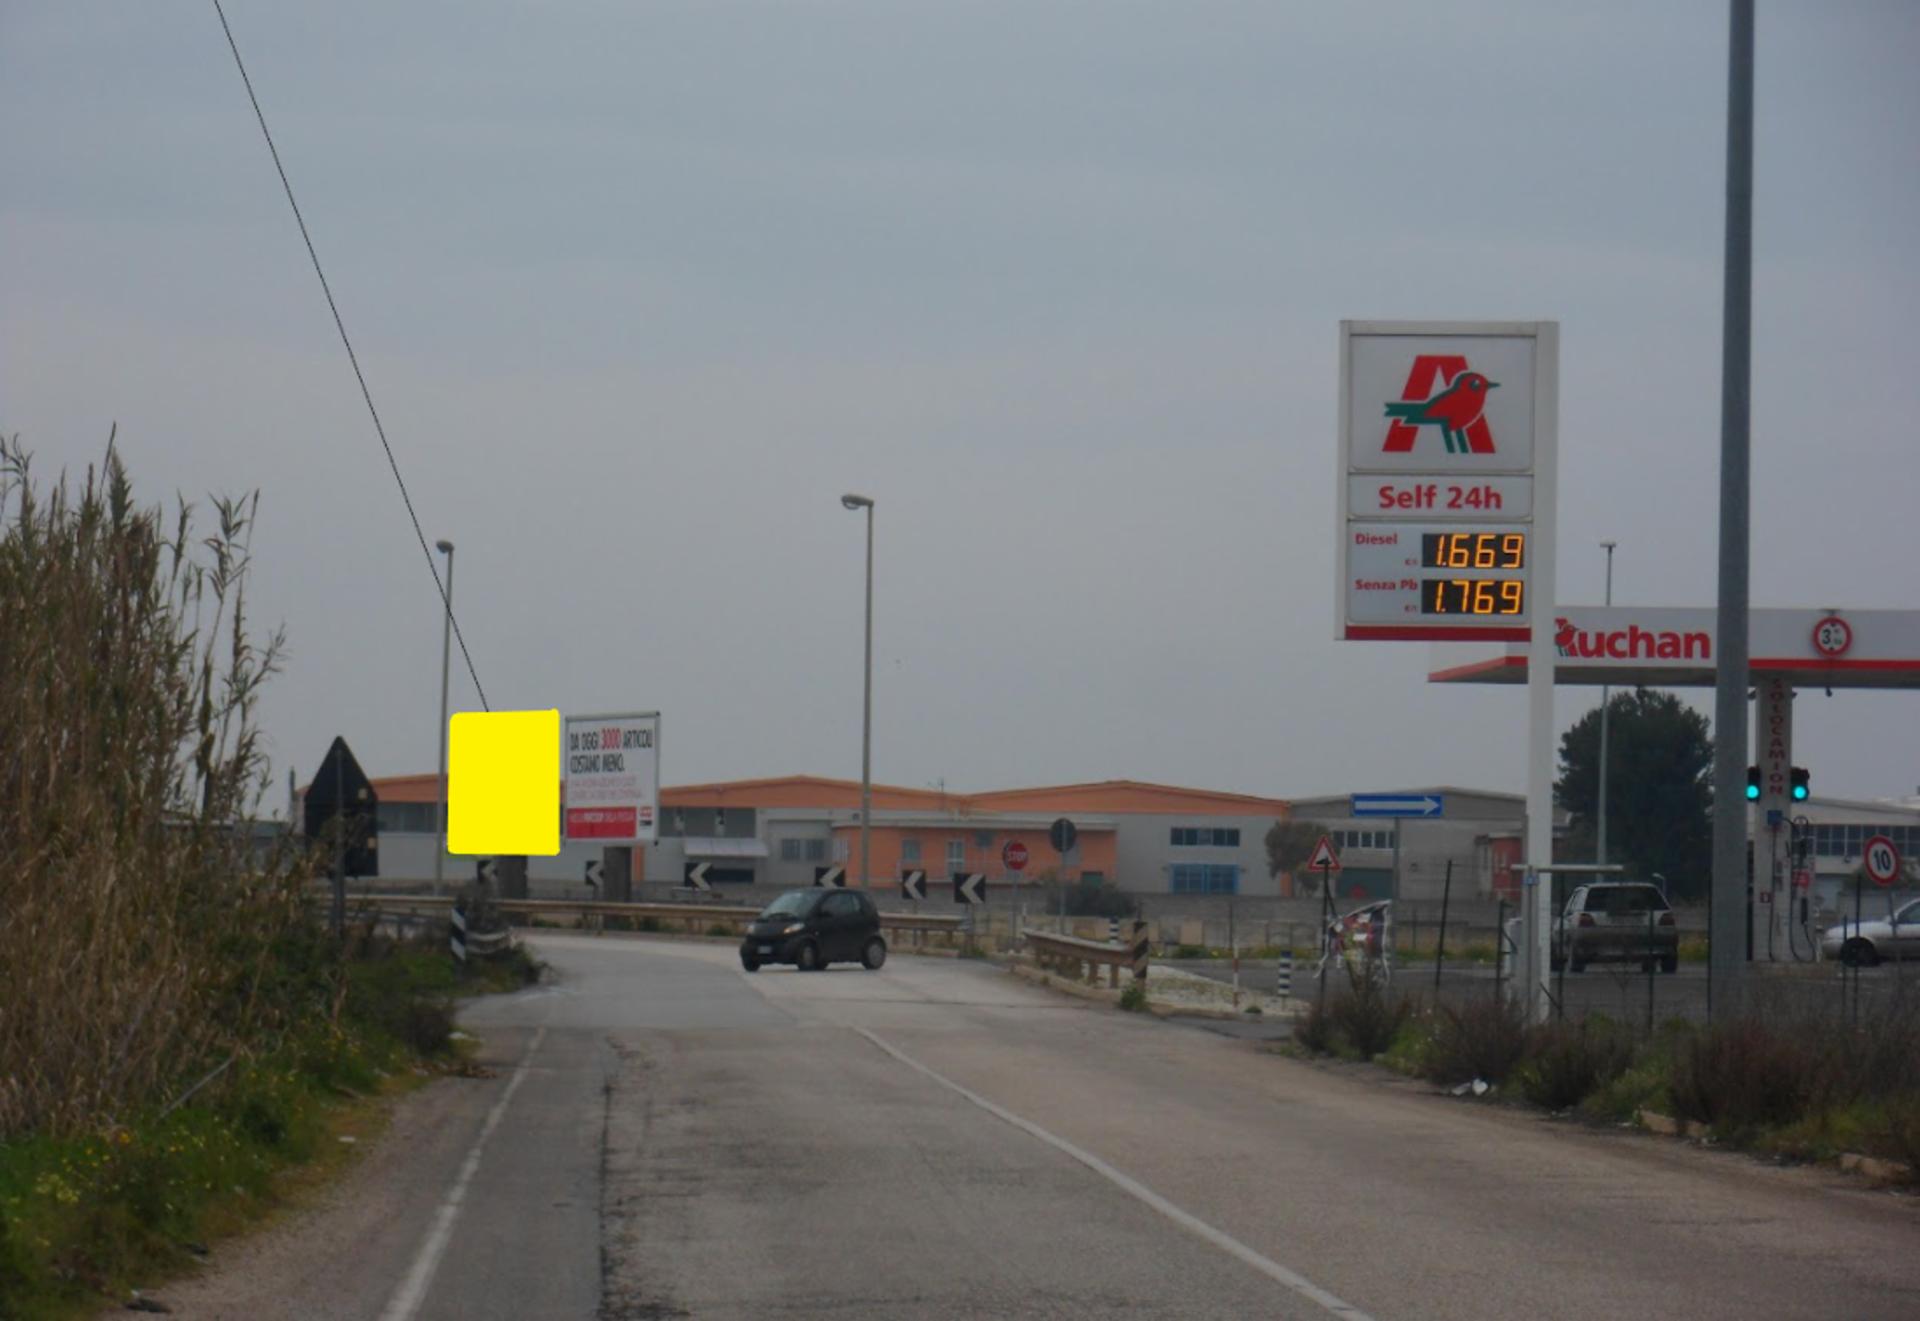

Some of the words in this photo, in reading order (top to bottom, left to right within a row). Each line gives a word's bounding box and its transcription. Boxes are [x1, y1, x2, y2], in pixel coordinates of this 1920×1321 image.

[1379, 485, 1437, 509] Self
[1446, 485, 1502, 509] 24h
[1355, 533, 1398, 545] Diesel
[1435, 533, 1524, 568] 1.669
[1355, 579, 1396, 591] Senza
[1400, 579, 1418, 591] Pb
[1435, 580, 1523, 614] 1.769
[601, 728, 621, 750] 3000
[1007, 851, 1026, 862] STOP
[1873, 849, 1891, 872] 10
